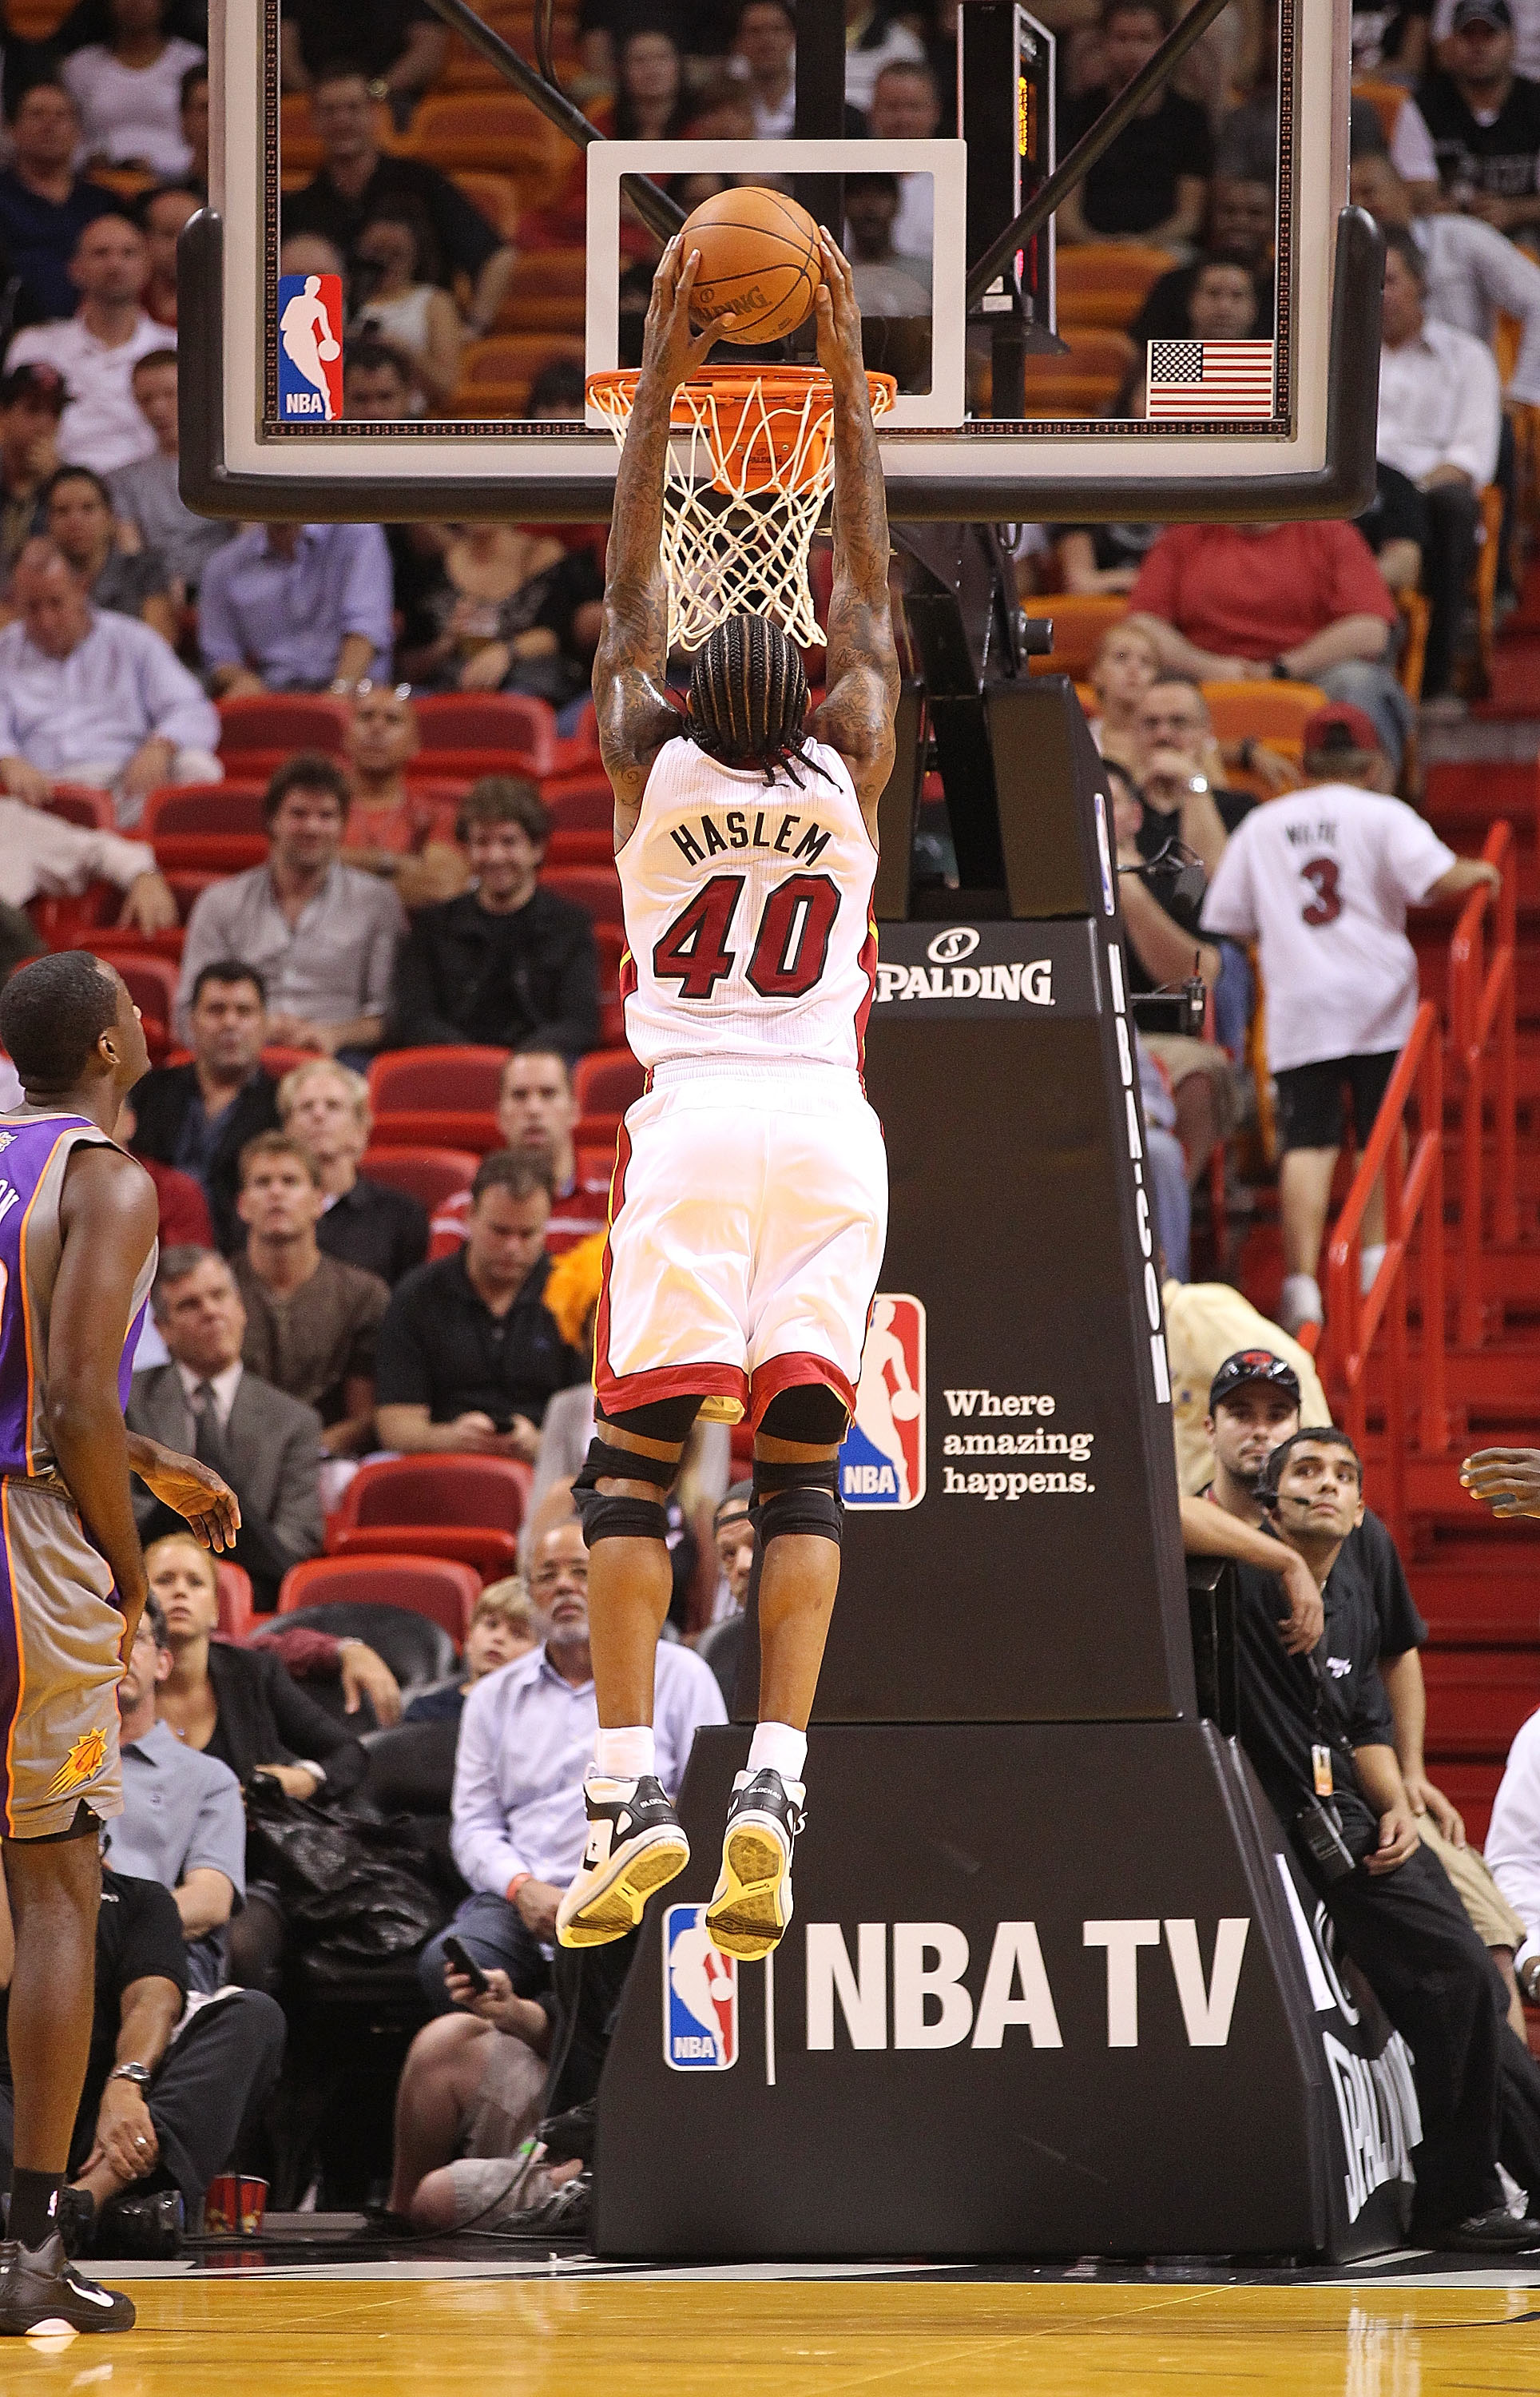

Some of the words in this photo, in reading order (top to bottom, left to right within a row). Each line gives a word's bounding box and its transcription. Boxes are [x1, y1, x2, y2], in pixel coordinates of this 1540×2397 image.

[286, 392, 323, 414] NBA
[669, 811, 832, 867] HASLEM
[1300, 857, 1342, 926] 3
[653, 873, 842, 1000] 40
[871, 959, 1054, 1006] PALDING
[944, 1389, 1056, 1417] Where
[943, 1428, 1094, 1462] amazing
[843, 1465, 896, 1495] NBA
[943, 1466, 1096, 1501] happens.
[805, 1921, 1063, 2051] NBA
[1082, 1918, 1251, 2048] TV
[673, 2036, 716, 2059] NBA
